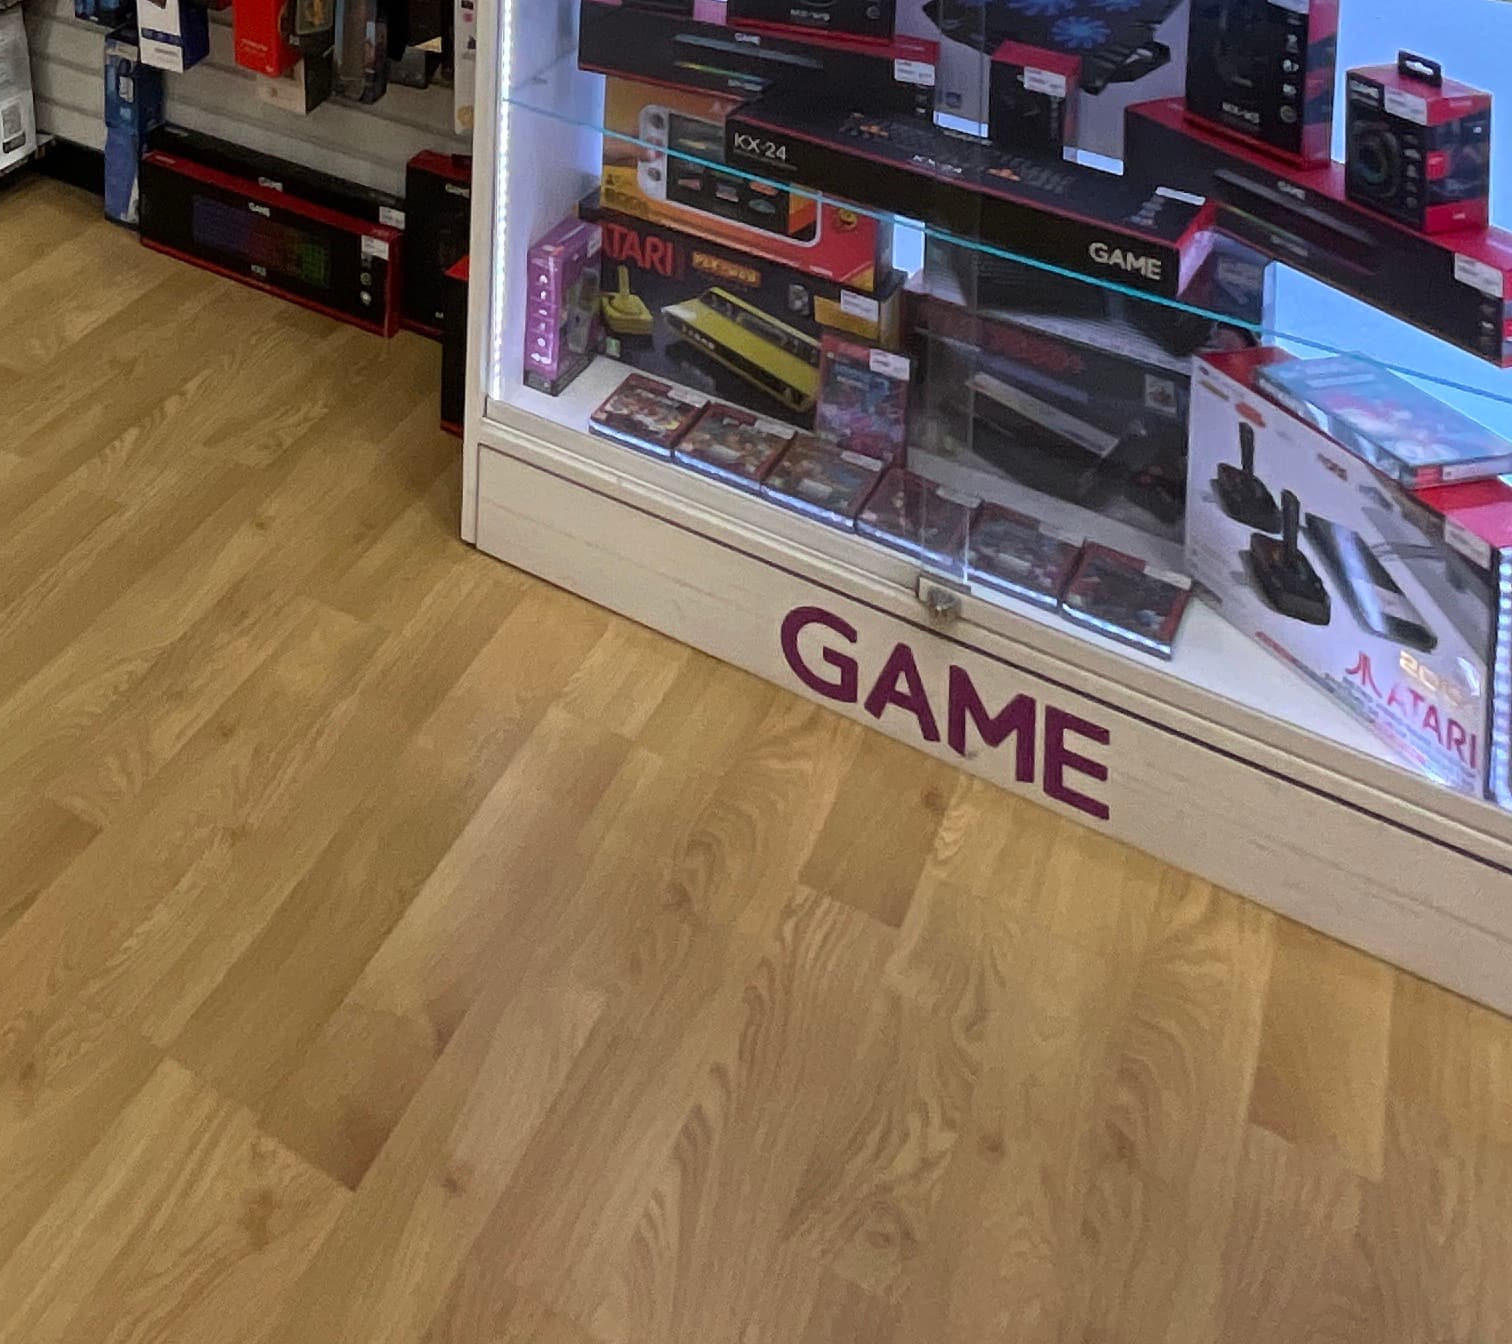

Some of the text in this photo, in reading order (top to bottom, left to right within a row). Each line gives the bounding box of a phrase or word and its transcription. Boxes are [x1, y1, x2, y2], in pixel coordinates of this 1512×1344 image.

[733, 132, 787, 163] KX-24
[1088, 242, 1162, 281] GAME
[780, 606, 1111, 821] GAME
[1388, 684, 1476, 769] ATARI
